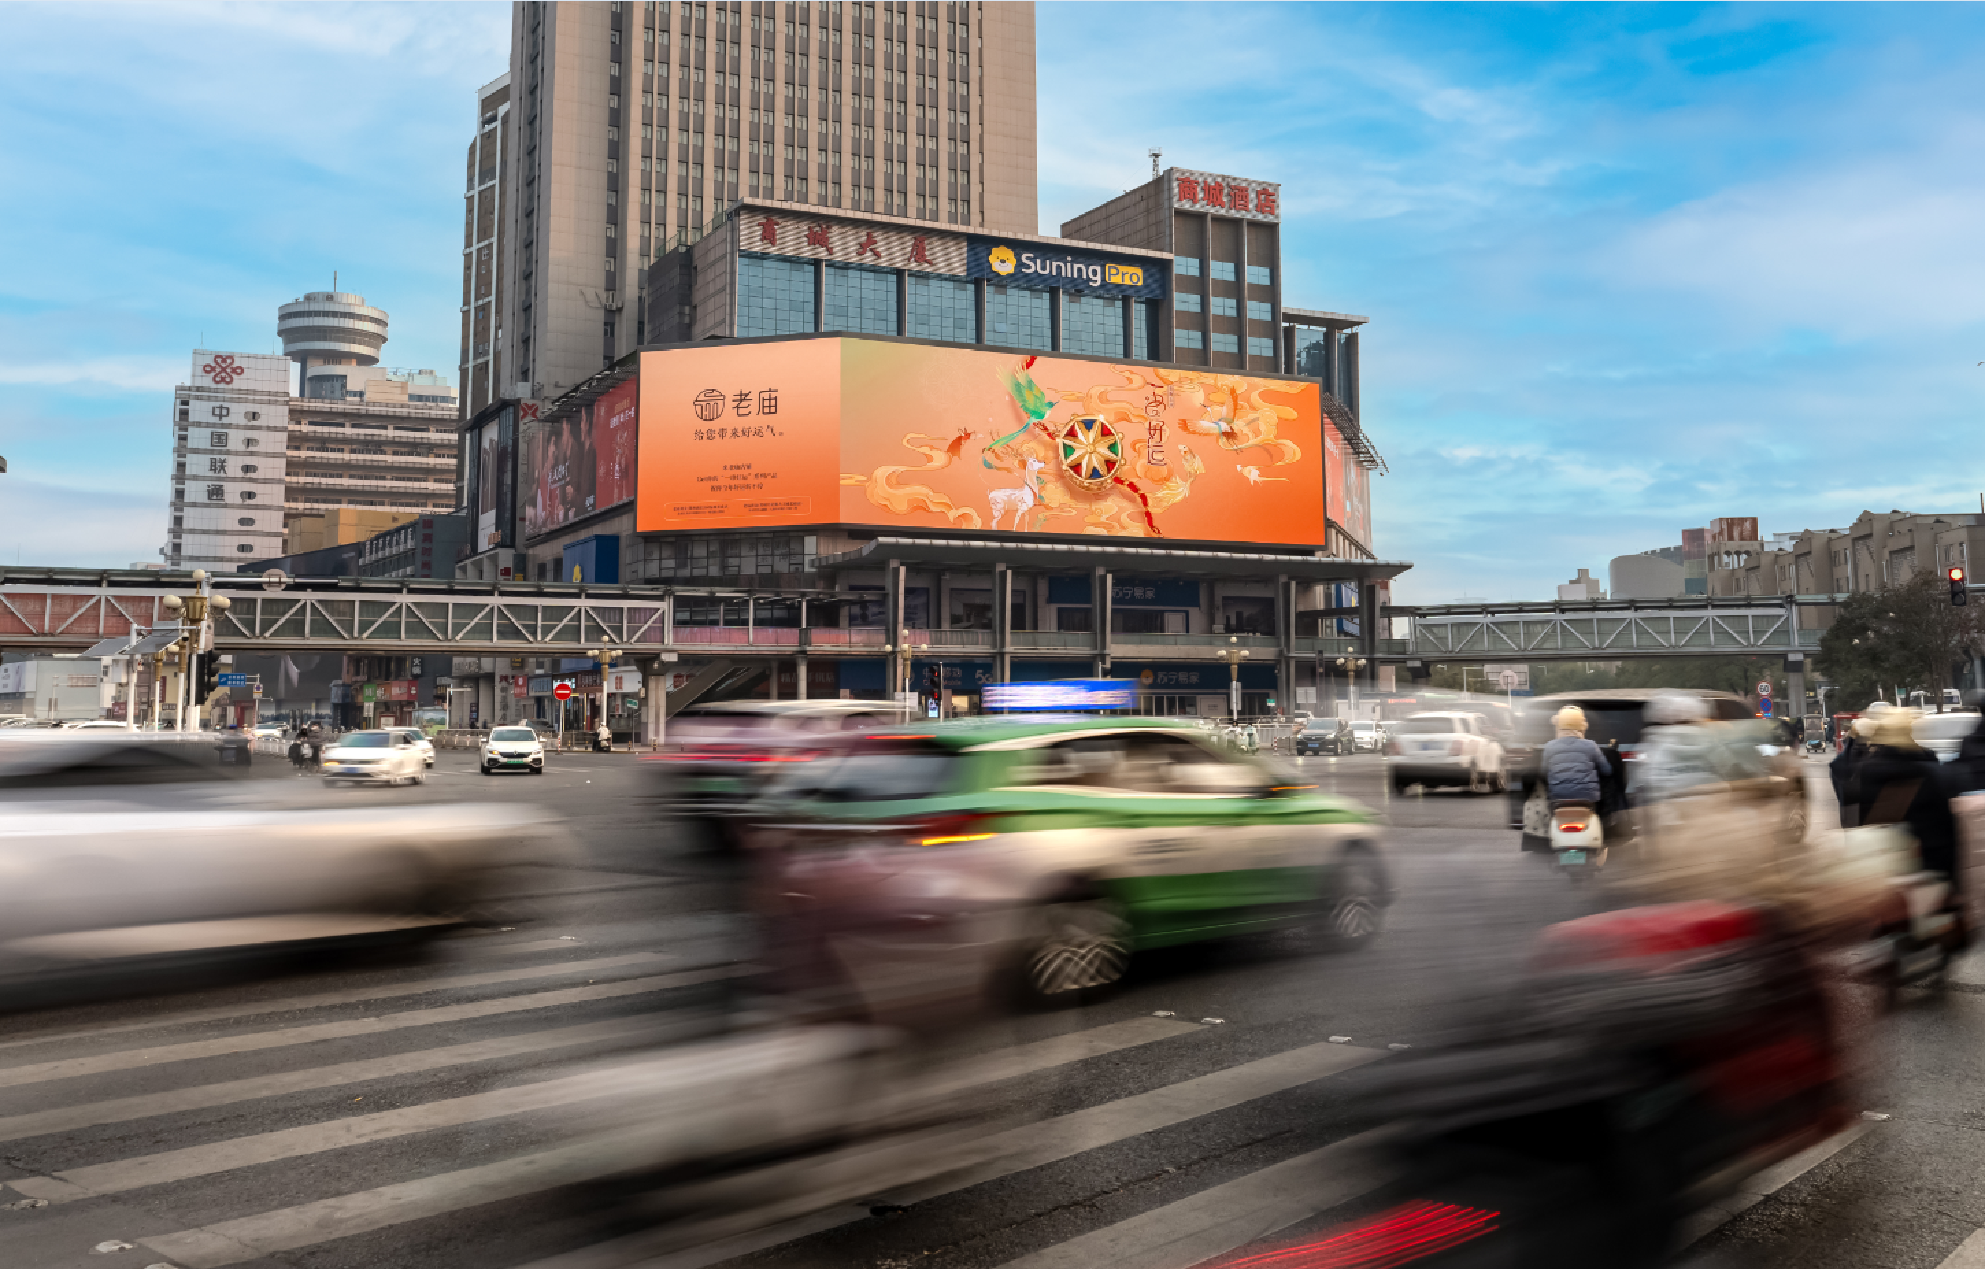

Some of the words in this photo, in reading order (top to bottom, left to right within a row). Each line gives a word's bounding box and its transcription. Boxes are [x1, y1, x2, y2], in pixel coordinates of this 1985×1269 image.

[1177, 177, 1275, 215] 商城酒店
[758, 217, 933, 265] 商城大厦
[1021, 254, 1101, 286] Suning
[1107, 266, 1140, 285] Pro
[732, 388, 778, 417] 老庙
[207, 404, 230, 501] 中国联通
[922, 666, 963, 678] 中移动
